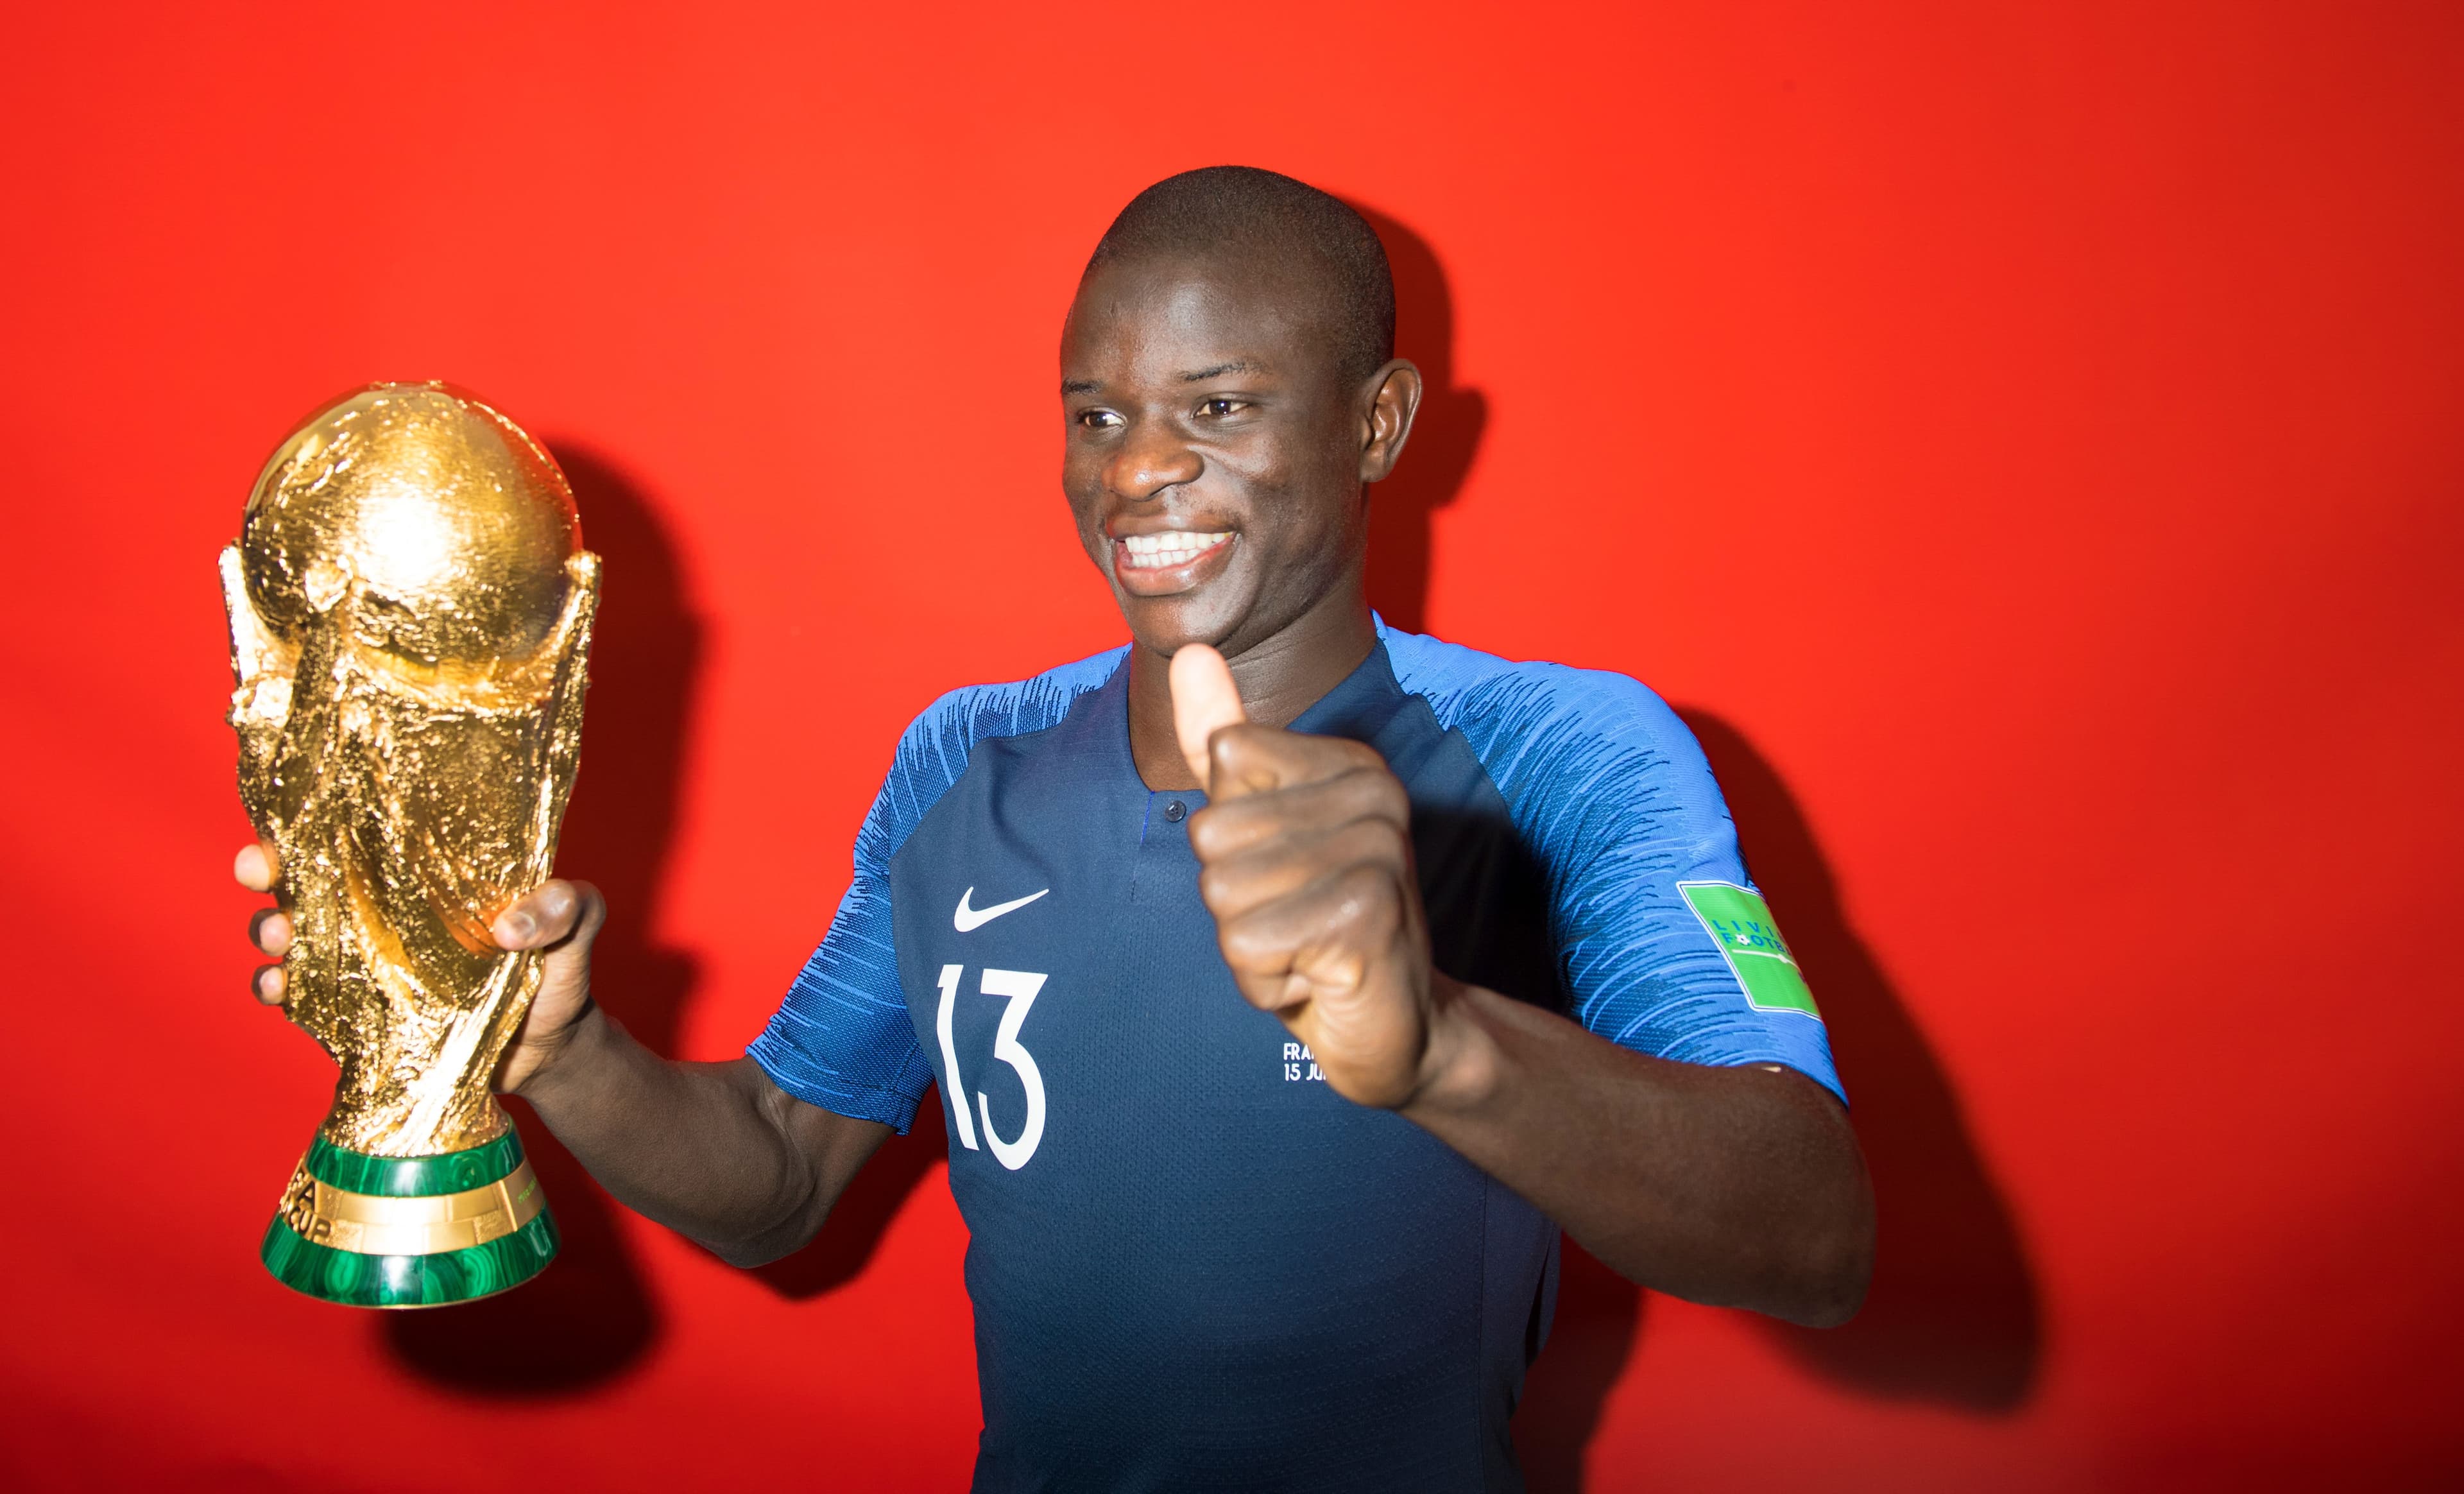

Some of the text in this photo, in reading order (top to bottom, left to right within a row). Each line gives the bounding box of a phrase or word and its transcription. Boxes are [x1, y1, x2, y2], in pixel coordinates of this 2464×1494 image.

[1283, 1043, 1315, 1060] FRA
[937, 965, 1048, 1171] 13
[1284, 1063, 1326, 1081] 15 JU
